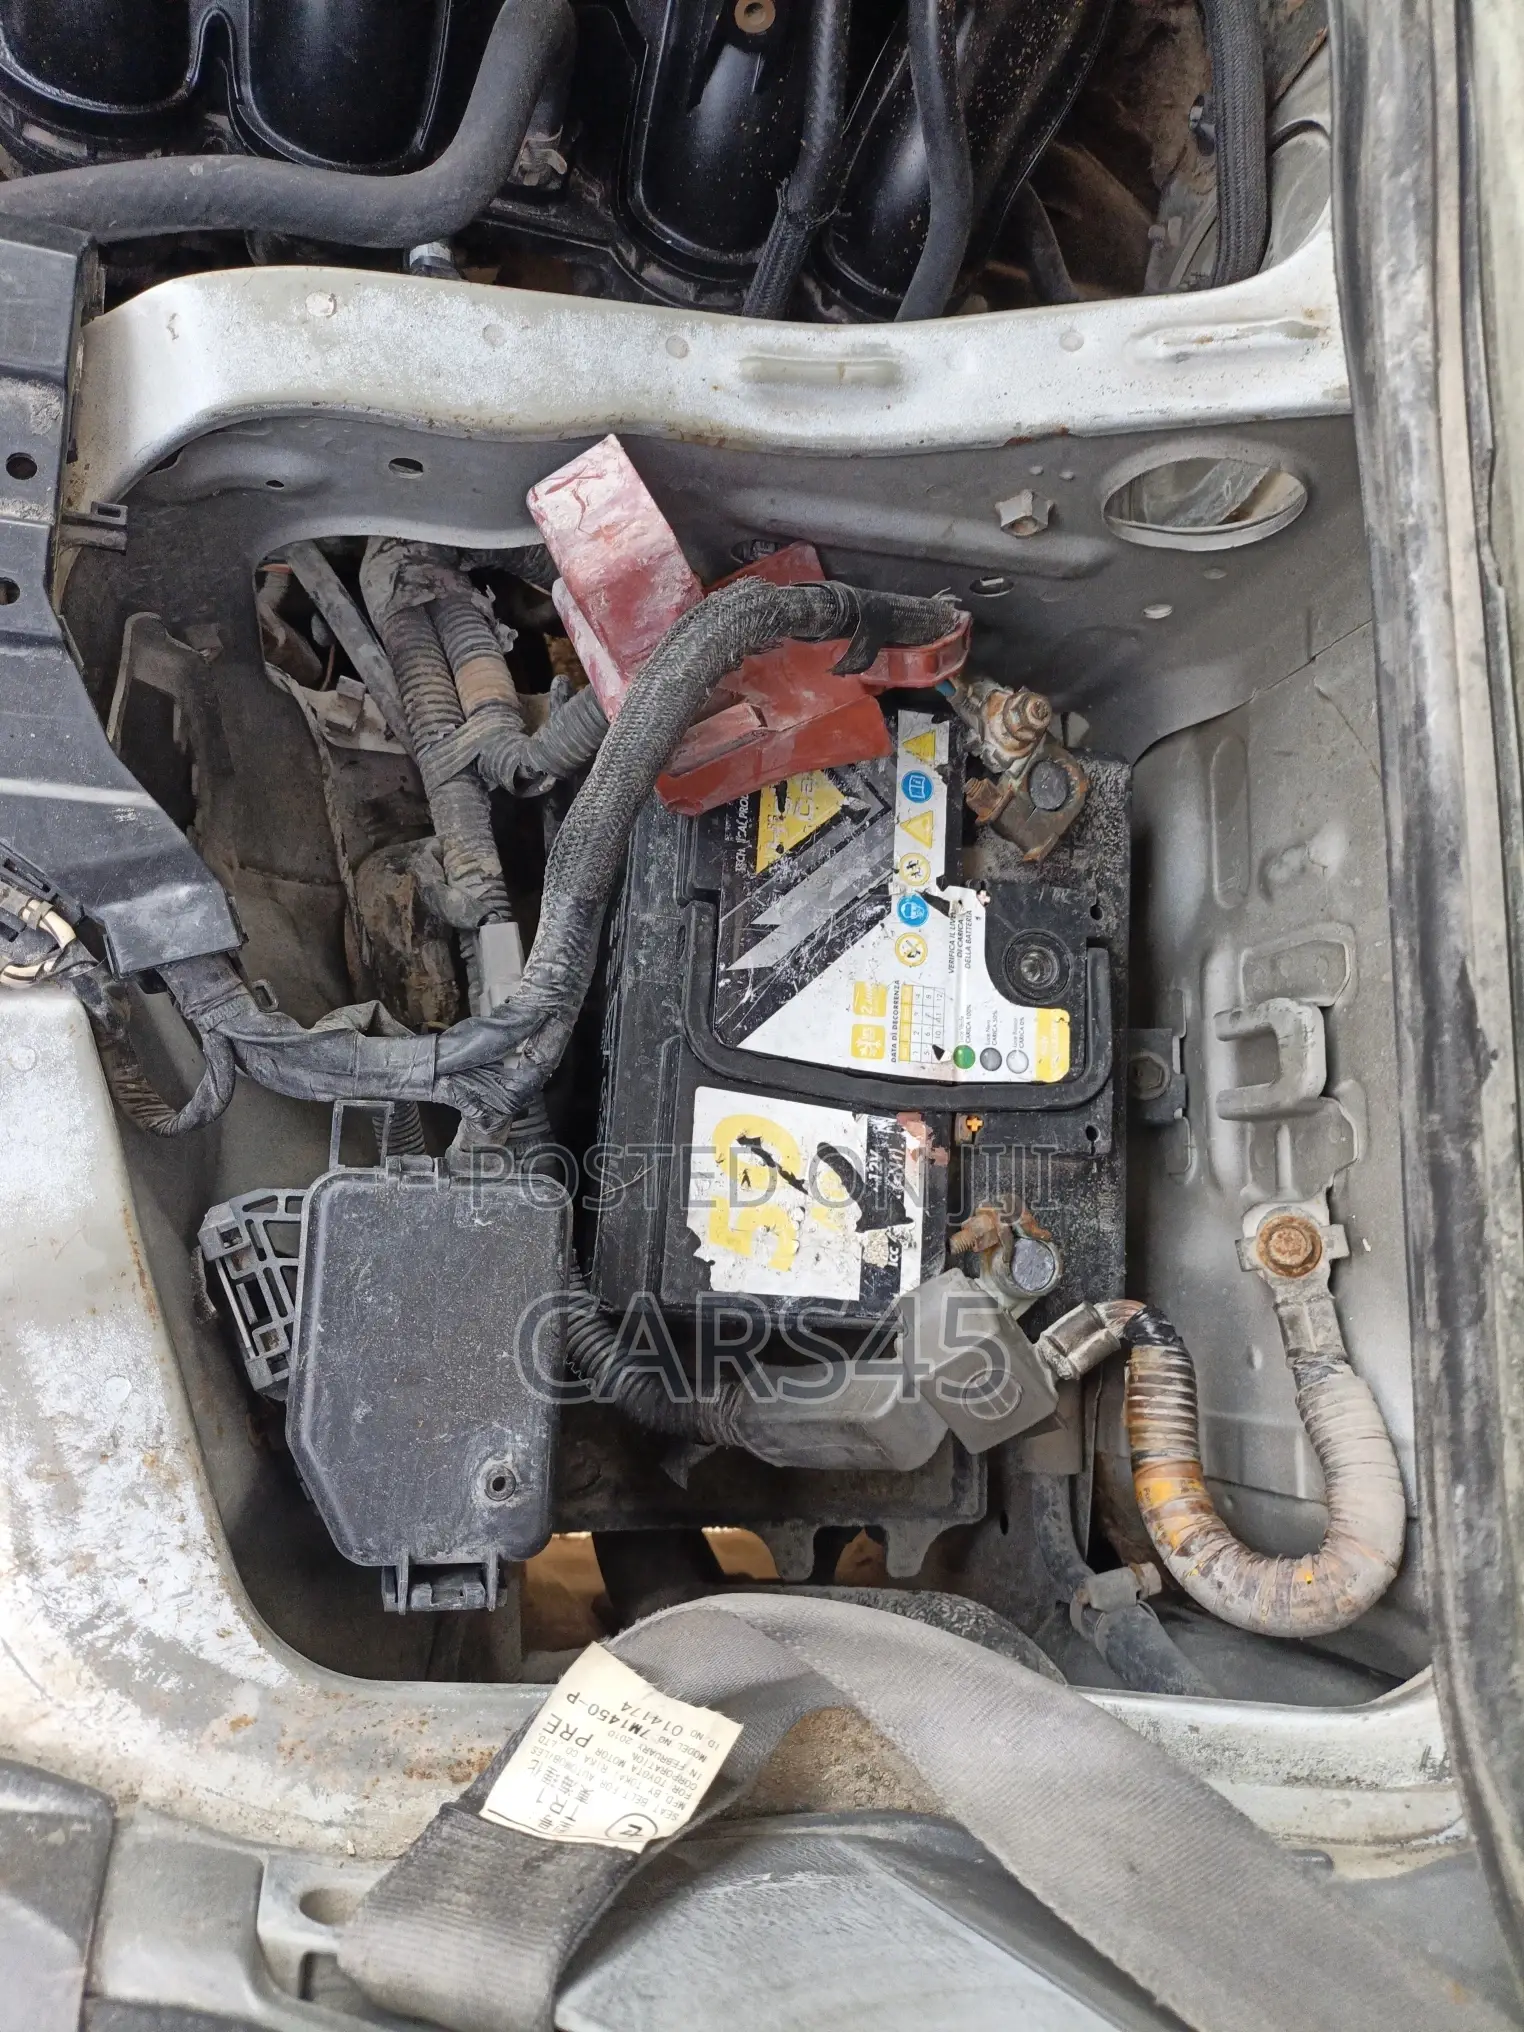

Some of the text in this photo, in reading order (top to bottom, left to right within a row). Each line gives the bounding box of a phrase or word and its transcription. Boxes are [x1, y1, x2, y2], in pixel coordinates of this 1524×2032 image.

[947, 940, 956, 974] VERIFICA
[964, 946, 972, 969] DELLA
[890, 979, 900, 1030] DECORRENZA
[890, 1043, 898, 1064] DATA
[540, 1712, 594, 1749] PRE
[593, 1746, 692, 1800] FOR TOYOTA MOTOR
[629, 1751, 698, 1791] CORPORATION
[636, 1741, 686, 1771] FEBRUARY
[534, 1786, 581, 1822] TR1
[621, 1787, 648, 1807] BELT
[652, 1801, 679, 1821] SEAT
